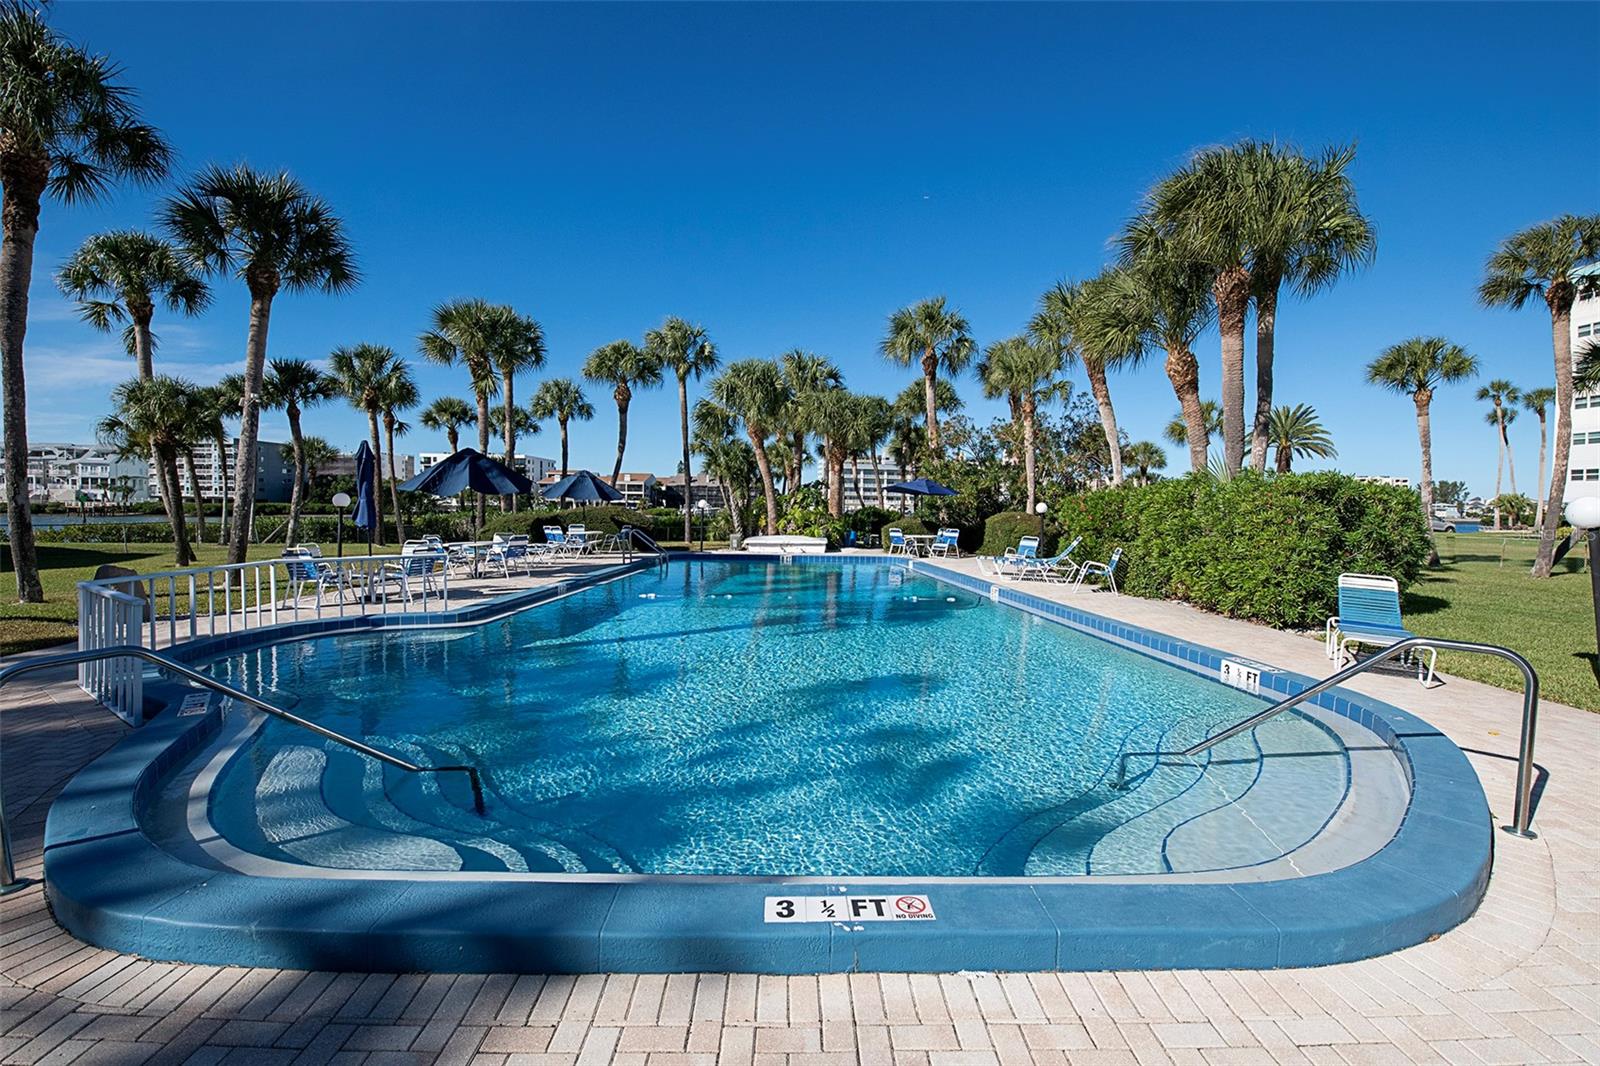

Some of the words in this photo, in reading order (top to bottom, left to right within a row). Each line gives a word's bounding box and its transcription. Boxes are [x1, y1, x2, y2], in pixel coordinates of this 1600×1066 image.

[1224, 664, 1230, 675] 3
[1246, 671, 1258, 683] FT
[775, 899, 796, 918] 3
[851, 899, 887, 917] FT
